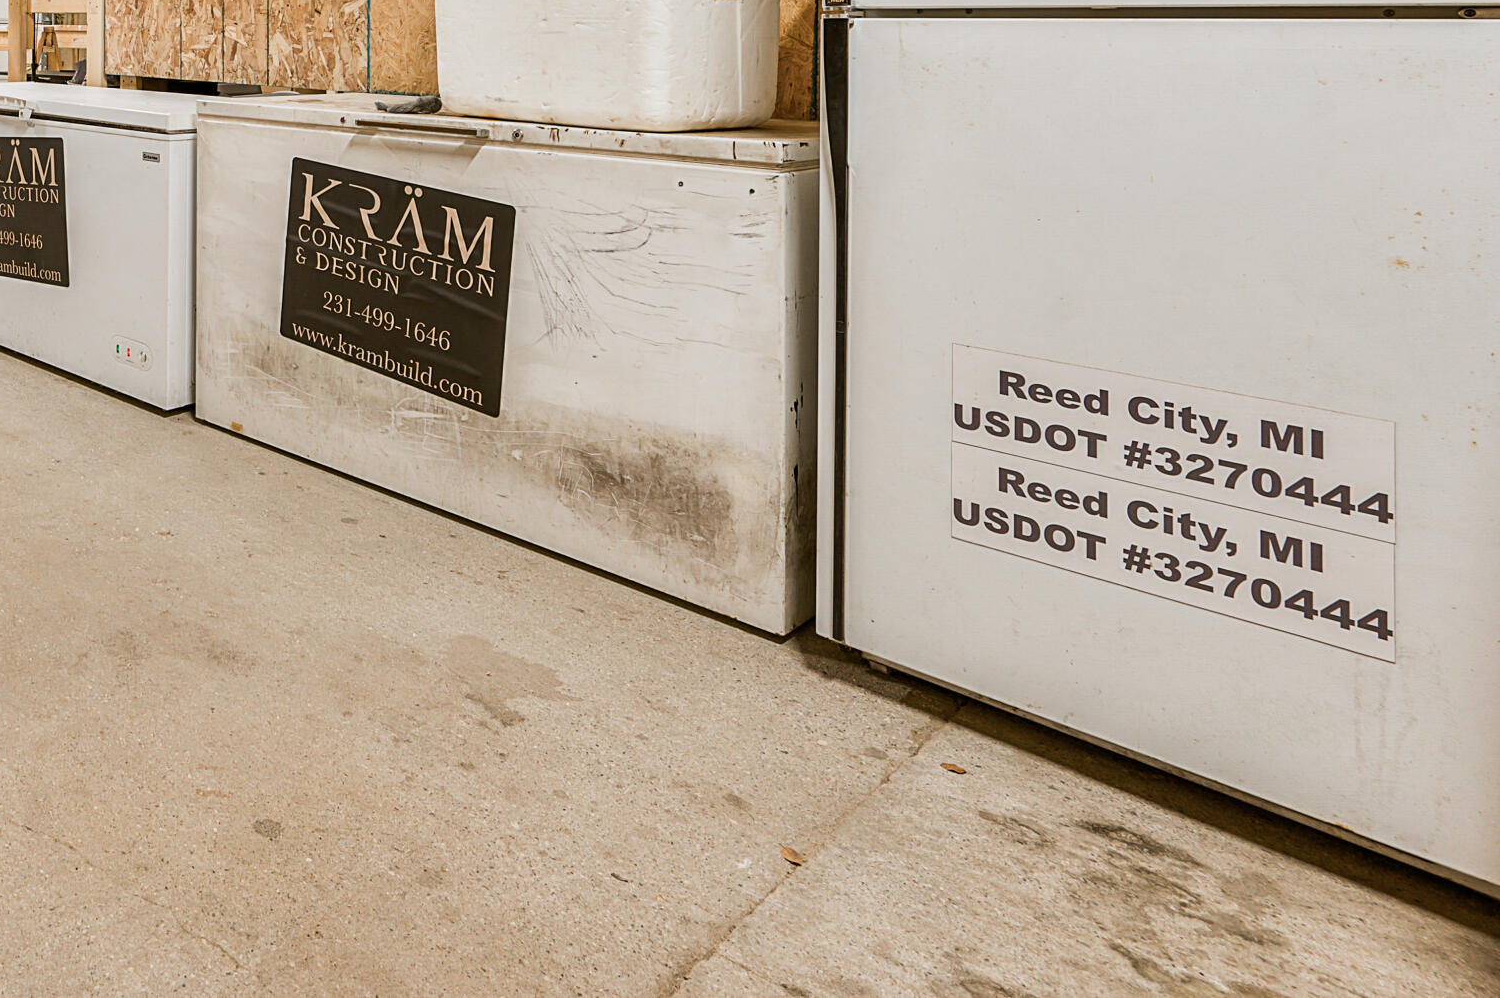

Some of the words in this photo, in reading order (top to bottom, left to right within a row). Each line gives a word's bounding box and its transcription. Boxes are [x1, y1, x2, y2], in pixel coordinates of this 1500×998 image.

[298, 223, 495, 297] CONSTRUCTION
[299, 172, 496, 273] KRÄM
[296, 246, 306, 264] &
[315, 251, 400, 295] DESIGN
[292, 322, 484, 407] www.krambuild.com
[323, 291, 451, 351] 231-499-1646
[999, 369, 1109, 416] Reed
[1127, 396, 1239, 449] City,
[1260, 419, 1325, 460] MI
[954, 403, 1107, 459] USDOT
[1123, 440, 1394, 524] #3270444
[998, 467, 1109, 518] Reed
[1126, 500, 1238, 557] City,
[1259, 530, 1324, 573] MI
[953, 497, 1107, 561] USDOT
[1123, 544, 1393, 641] #3270444
